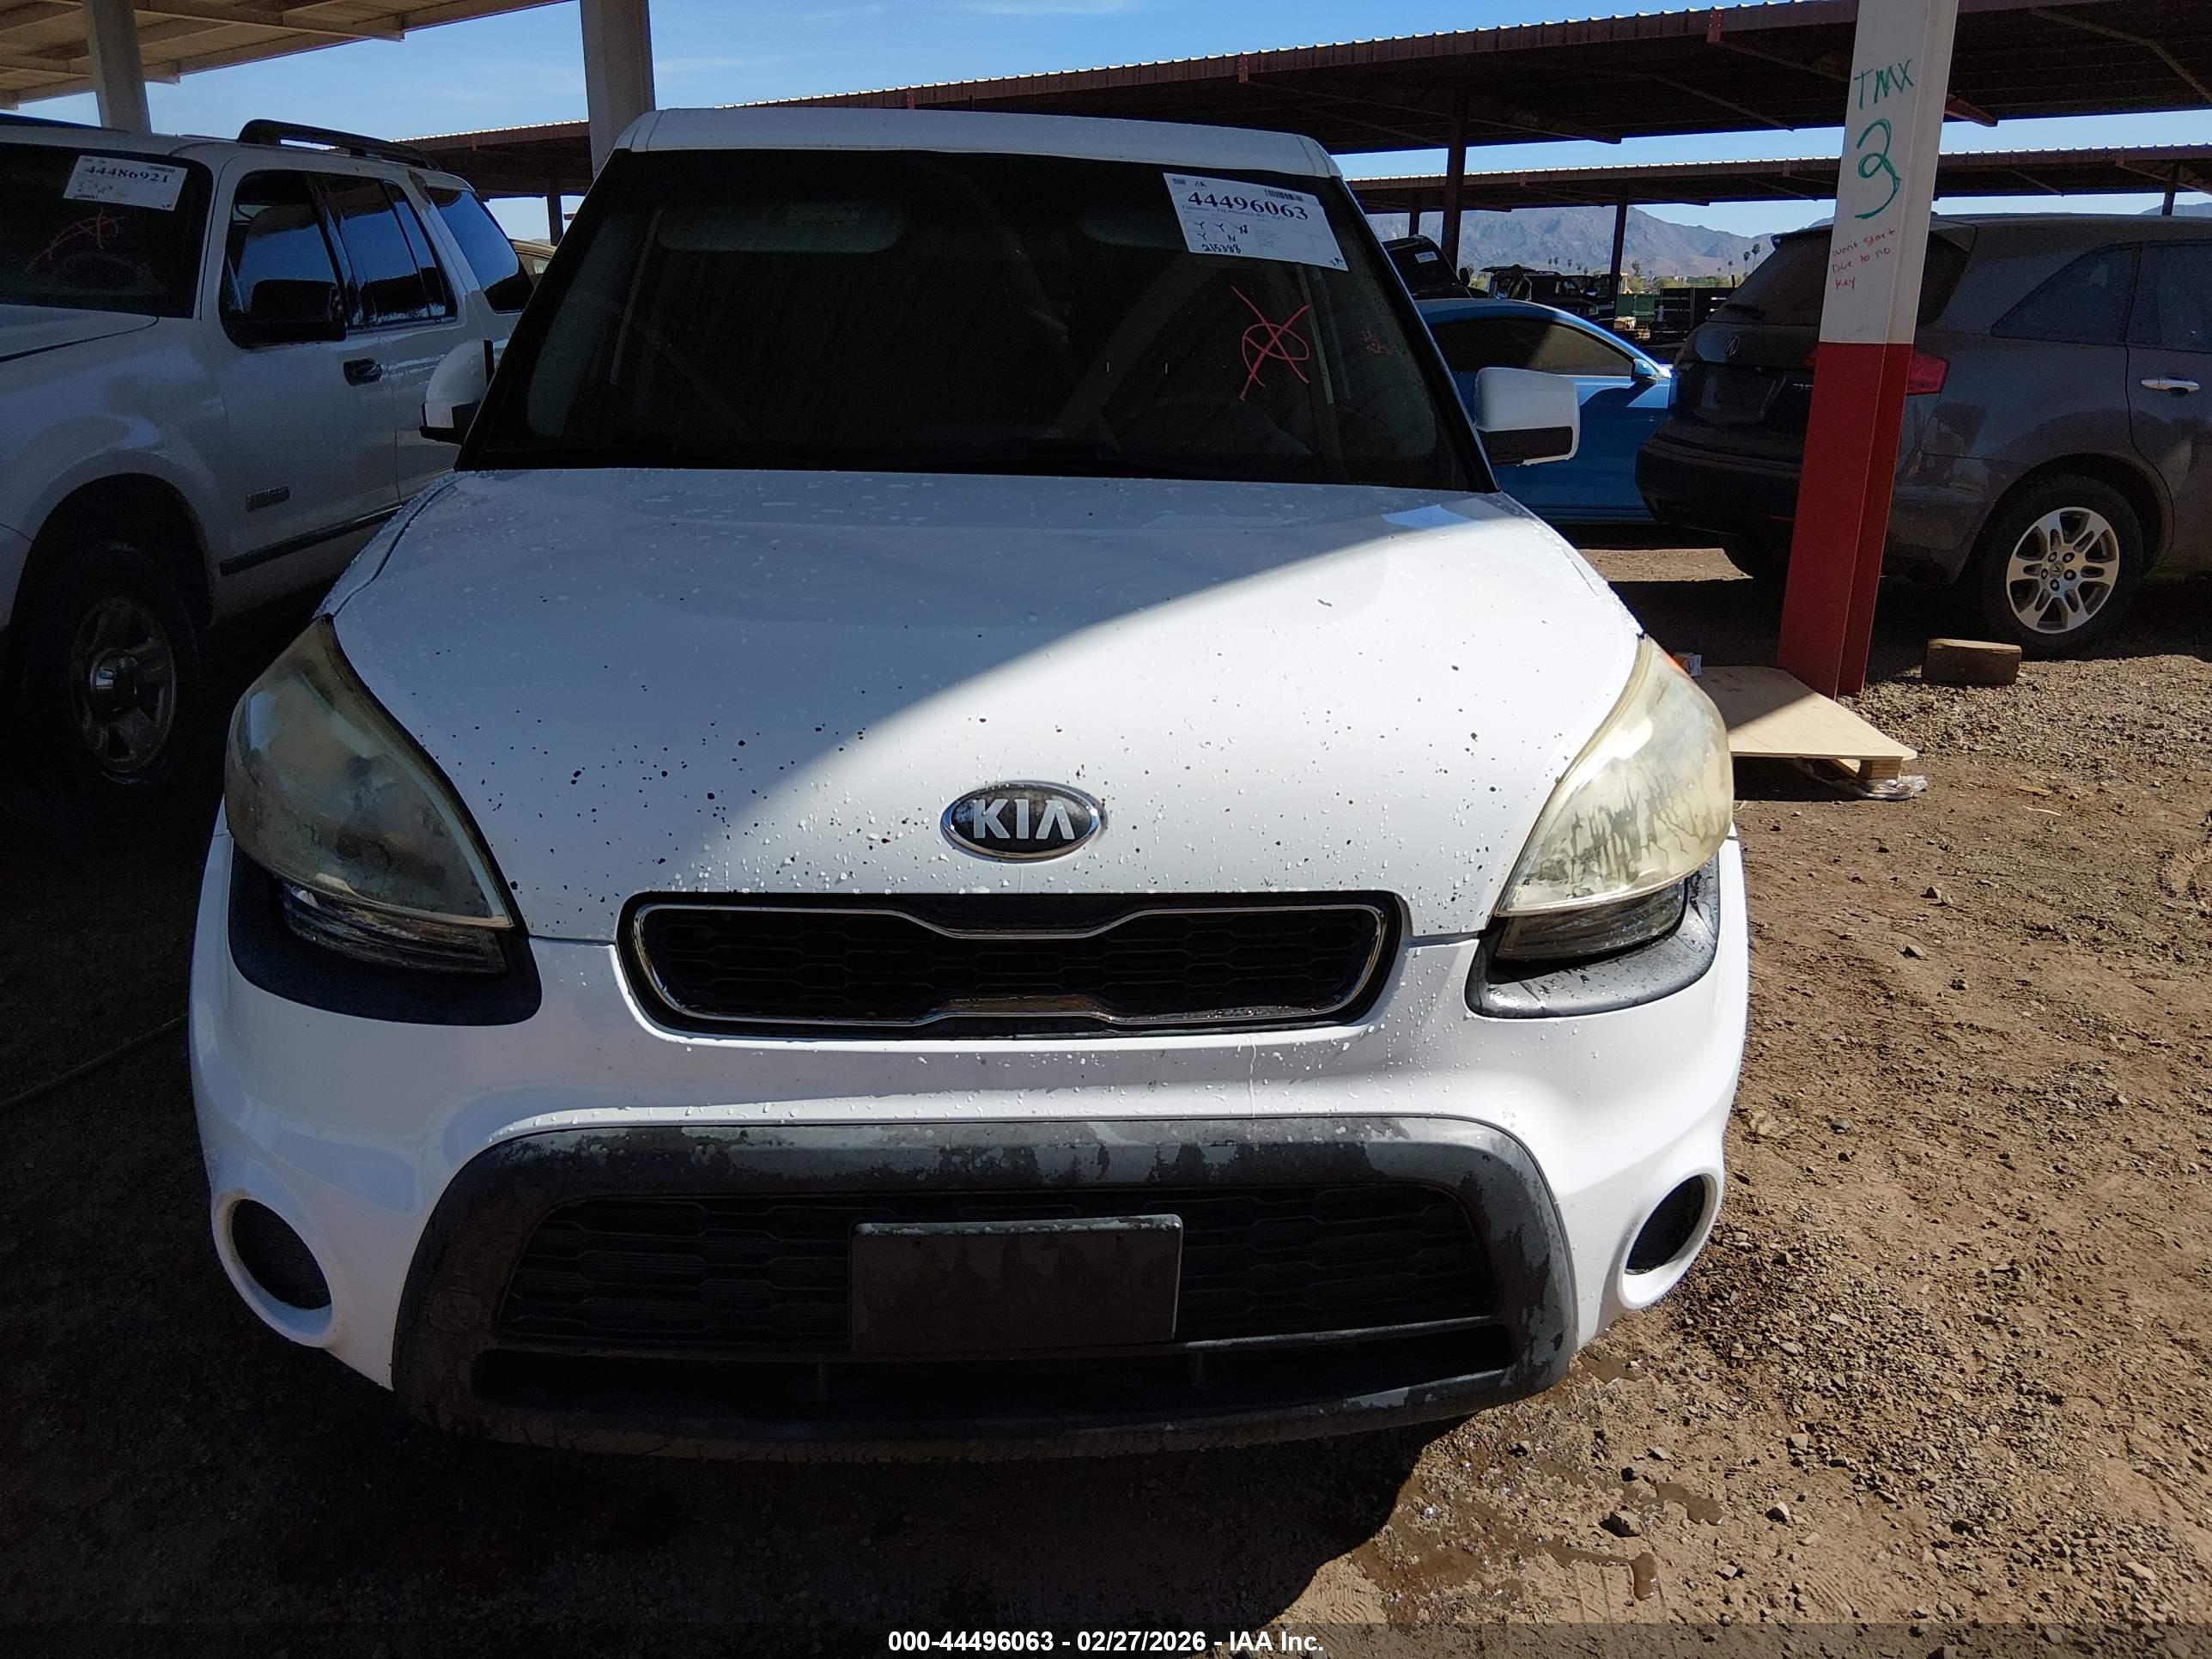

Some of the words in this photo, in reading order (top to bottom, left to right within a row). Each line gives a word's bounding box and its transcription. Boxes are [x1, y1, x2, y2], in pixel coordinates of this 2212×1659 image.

[1854, 59, 1913, 110] TMX
[85, 166, 168, 183] 44486921
[1188, 191, 1309, 221] 44496063
[973, 799, 1075, 840] KIA
